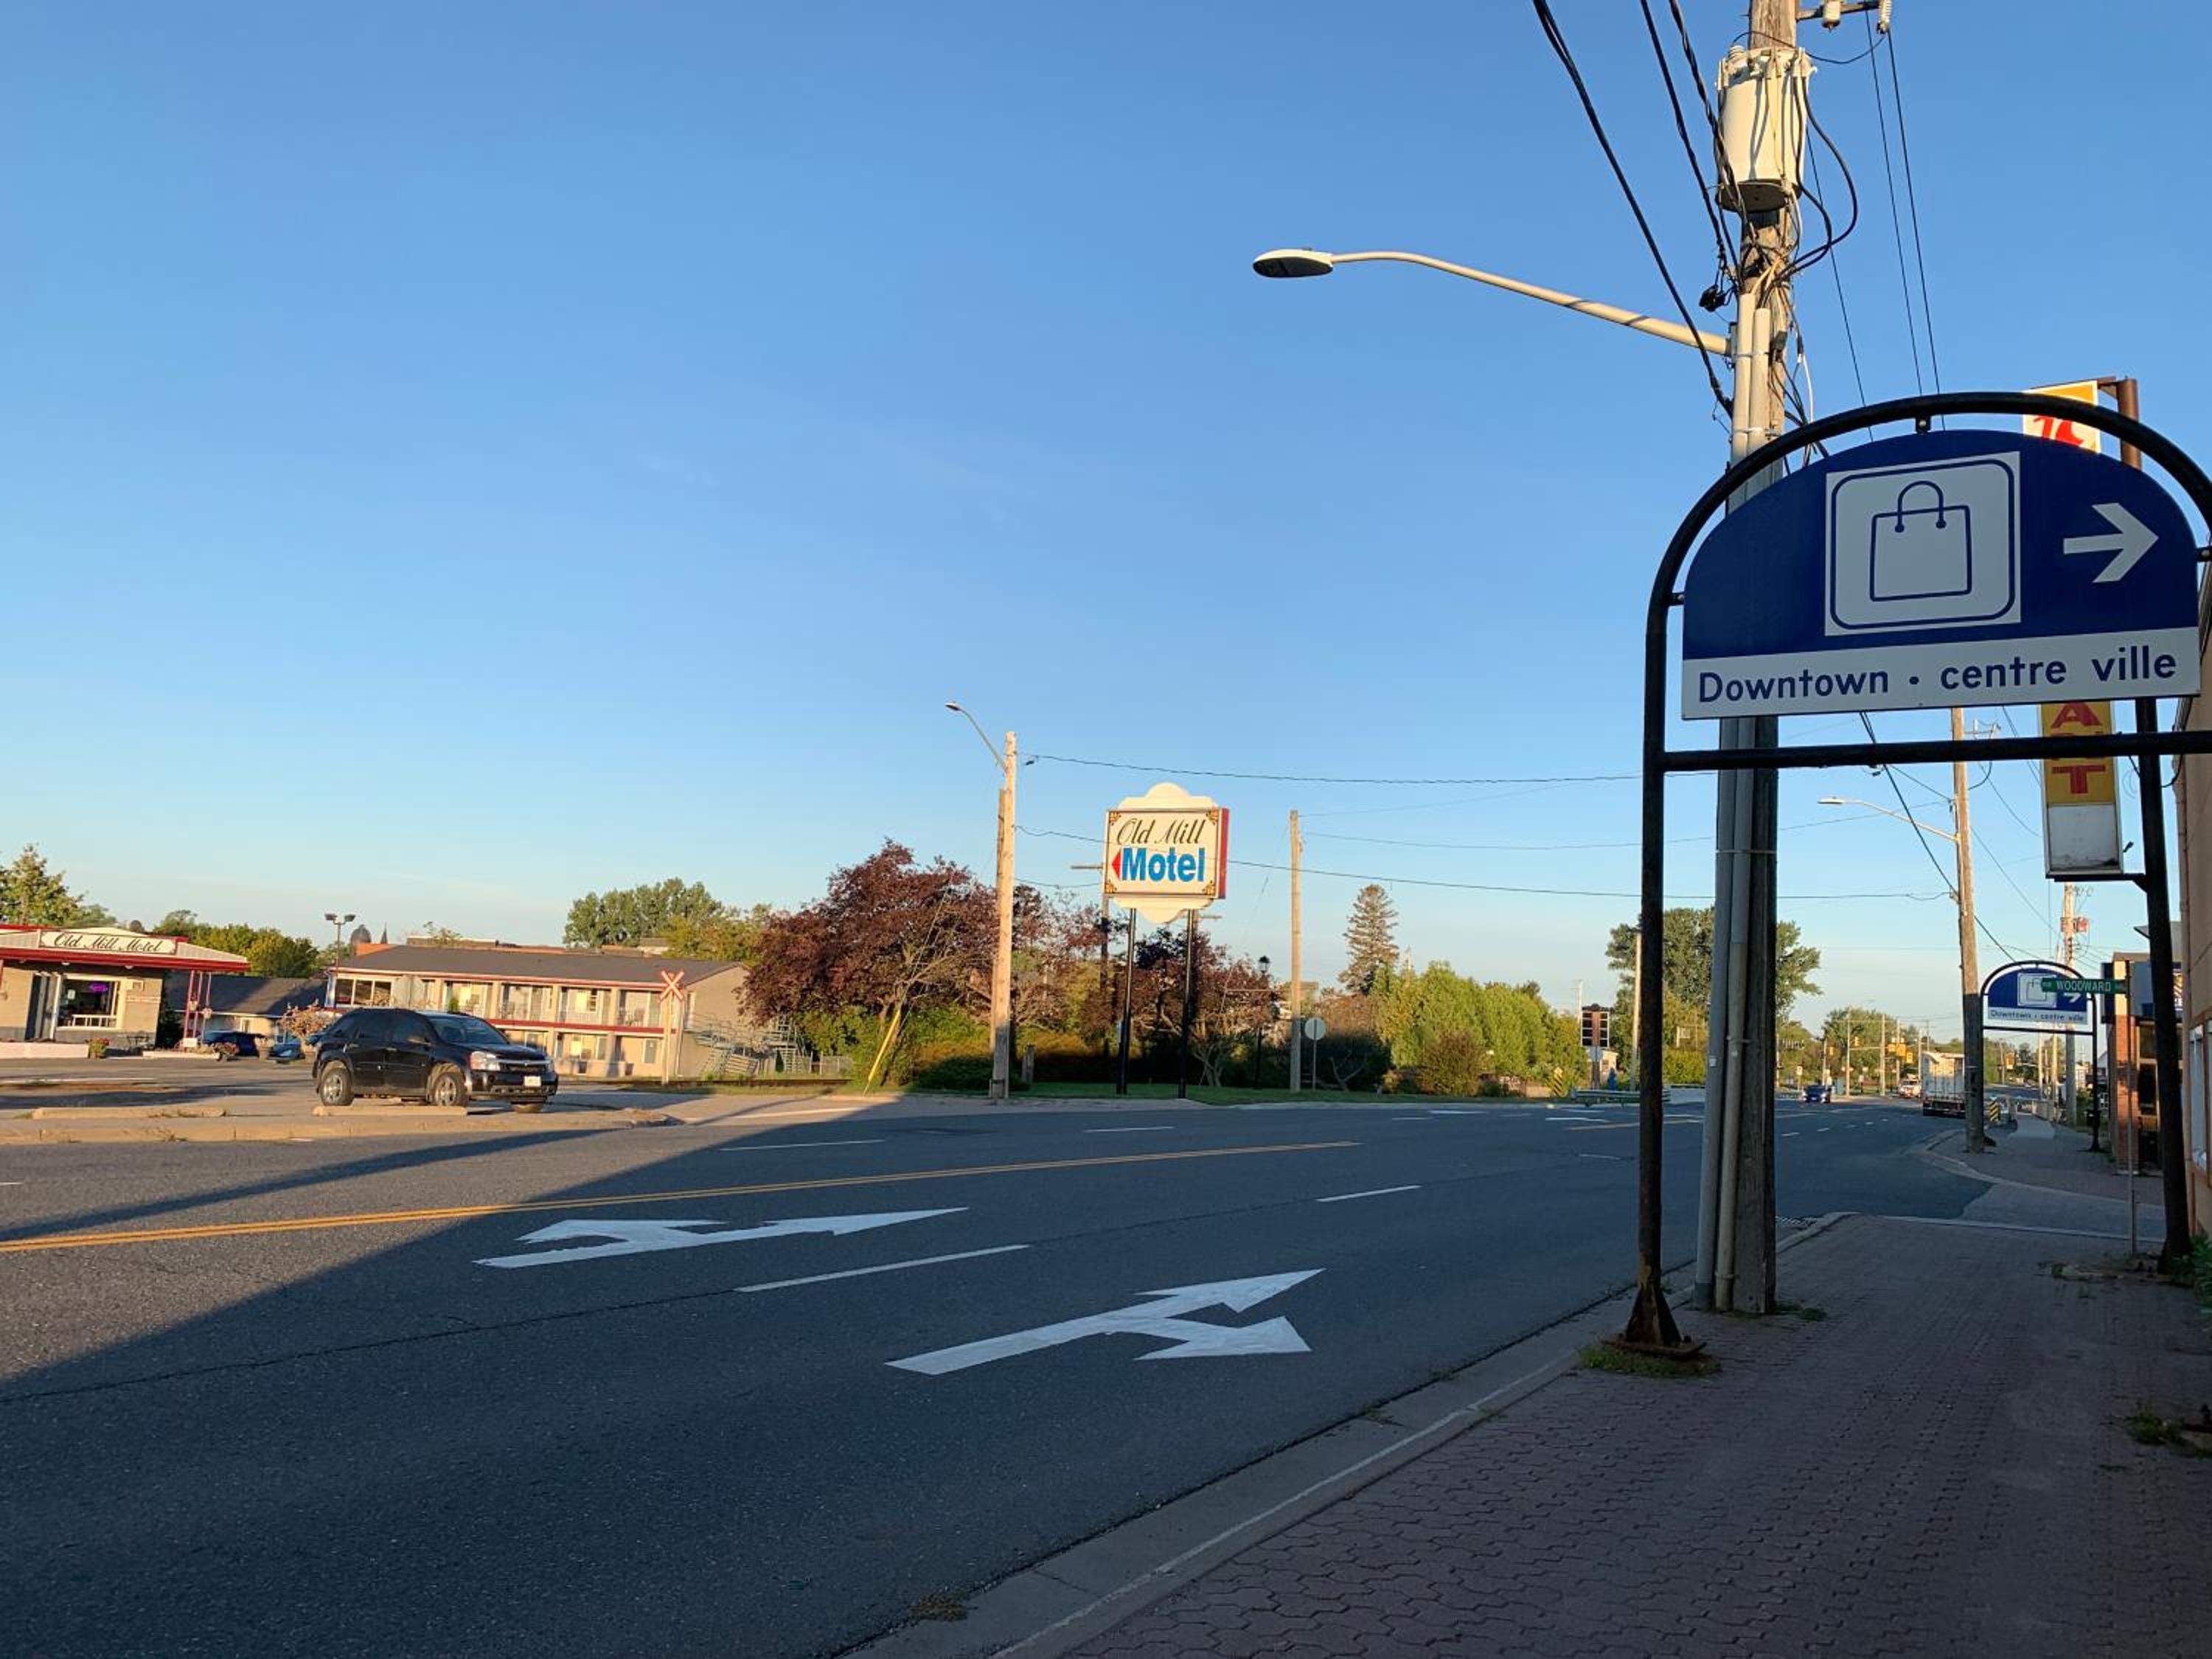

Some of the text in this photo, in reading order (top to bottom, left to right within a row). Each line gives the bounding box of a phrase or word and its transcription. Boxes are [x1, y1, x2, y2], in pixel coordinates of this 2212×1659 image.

[1700, 646, 2177, 703] Downtown centre ville
[1116, 818, 1206, 846] Old Mill
[1122, 847, 1205, 882] Motel
[54, 933, 161, 951] Old Mill Motel
[2056, 980, 2111, 992] WOODWARD
